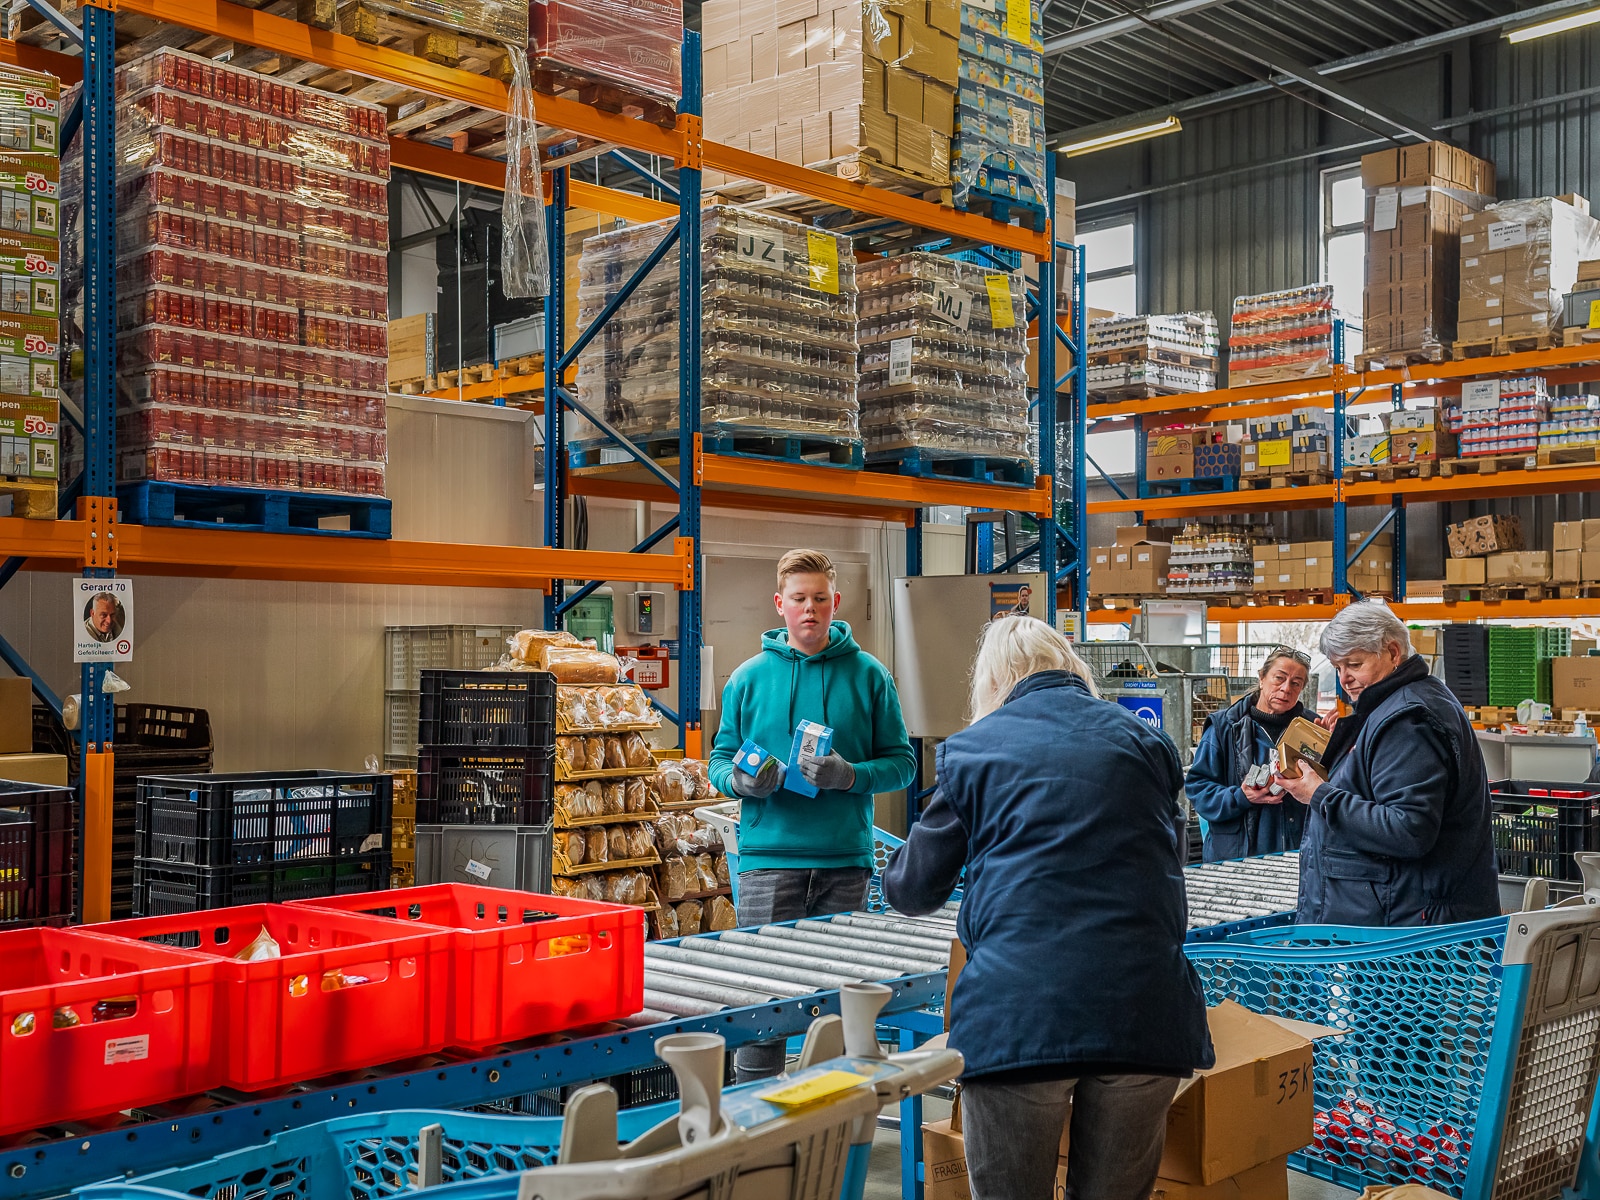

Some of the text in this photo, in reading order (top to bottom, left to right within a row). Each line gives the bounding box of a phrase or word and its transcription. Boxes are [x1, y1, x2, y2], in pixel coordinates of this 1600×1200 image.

[563, 28, 601, 47] Brossard
[633, 50, 669, 68] Brossard
[937, 290, 963, 320] MJ
[80, 583, 113, 591] Gerard
[934, 1161, 968, 1178] FRAGIL
